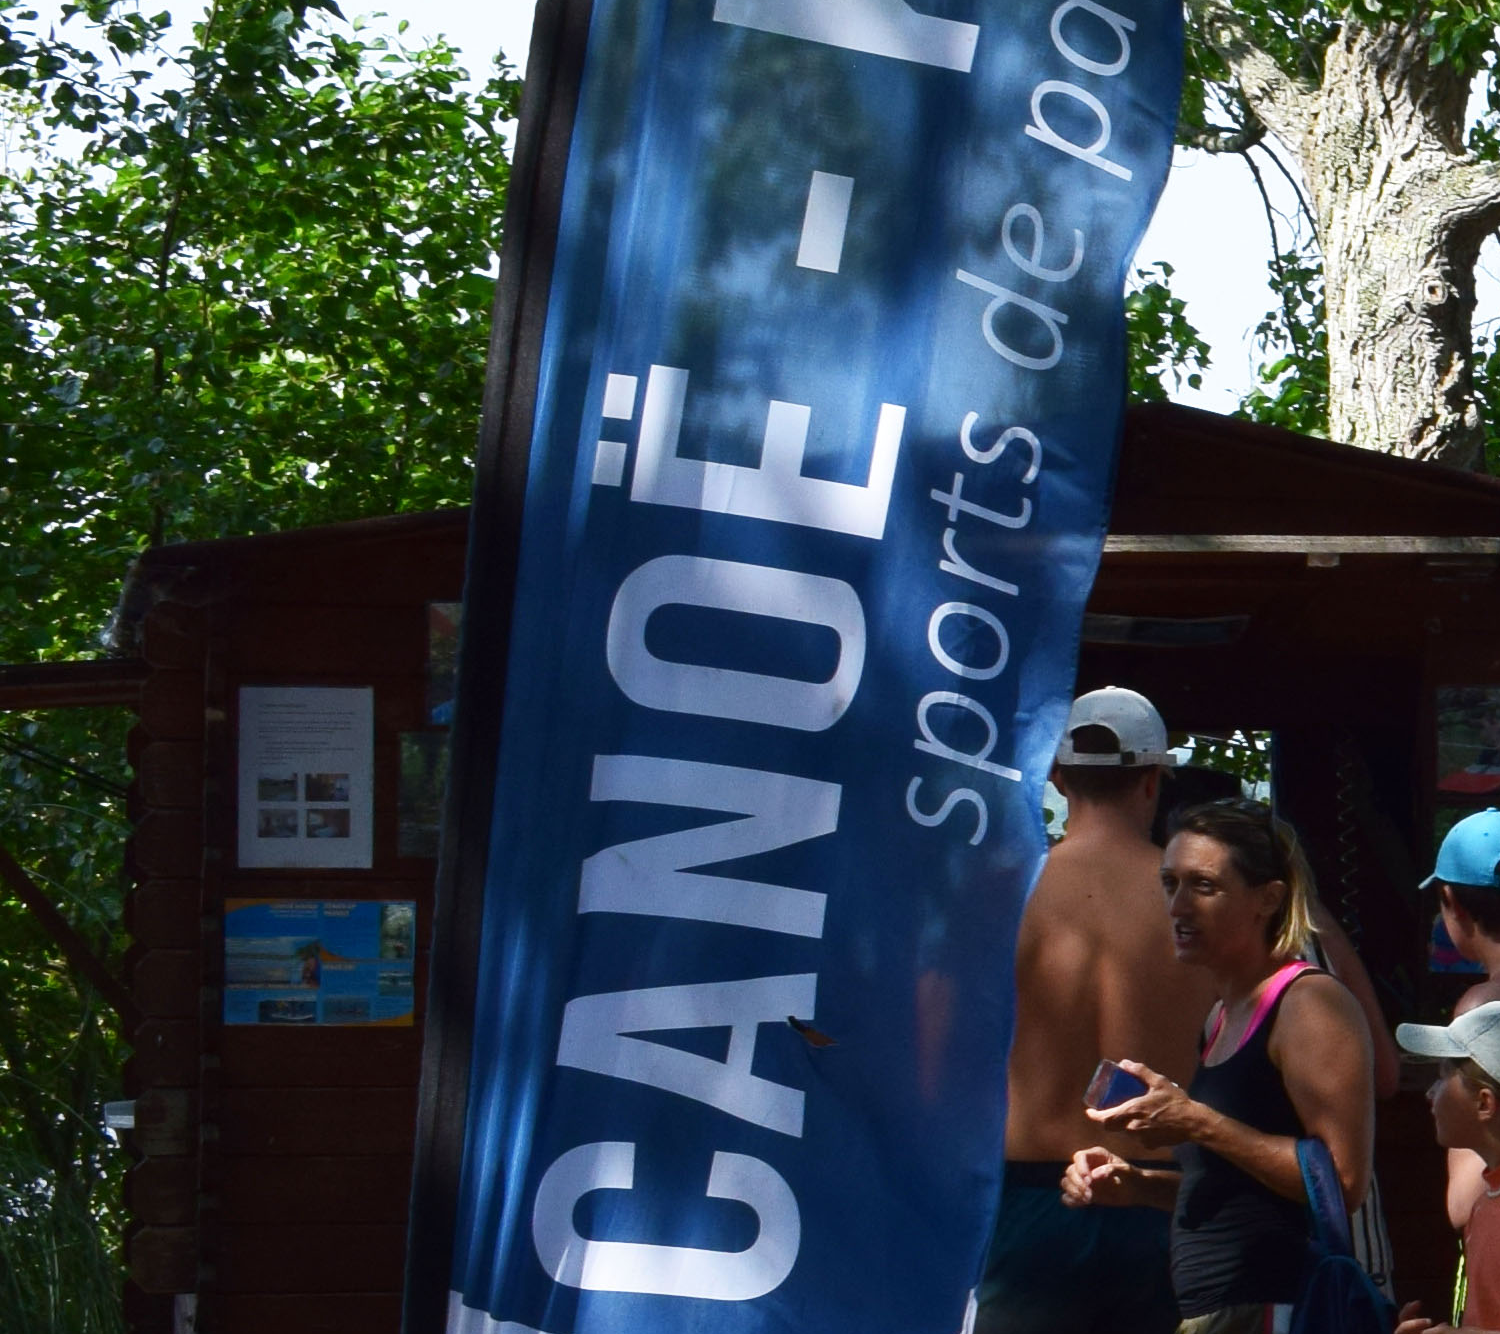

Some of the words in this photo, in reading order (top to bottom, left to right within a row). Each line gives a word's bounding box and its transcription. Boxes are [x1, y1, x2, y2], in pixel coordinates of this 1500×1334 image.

[956, 202, 1085, 372] de
[531, 365, 905, 1303] CANOË
[907, 410, 1041, 847] sports
